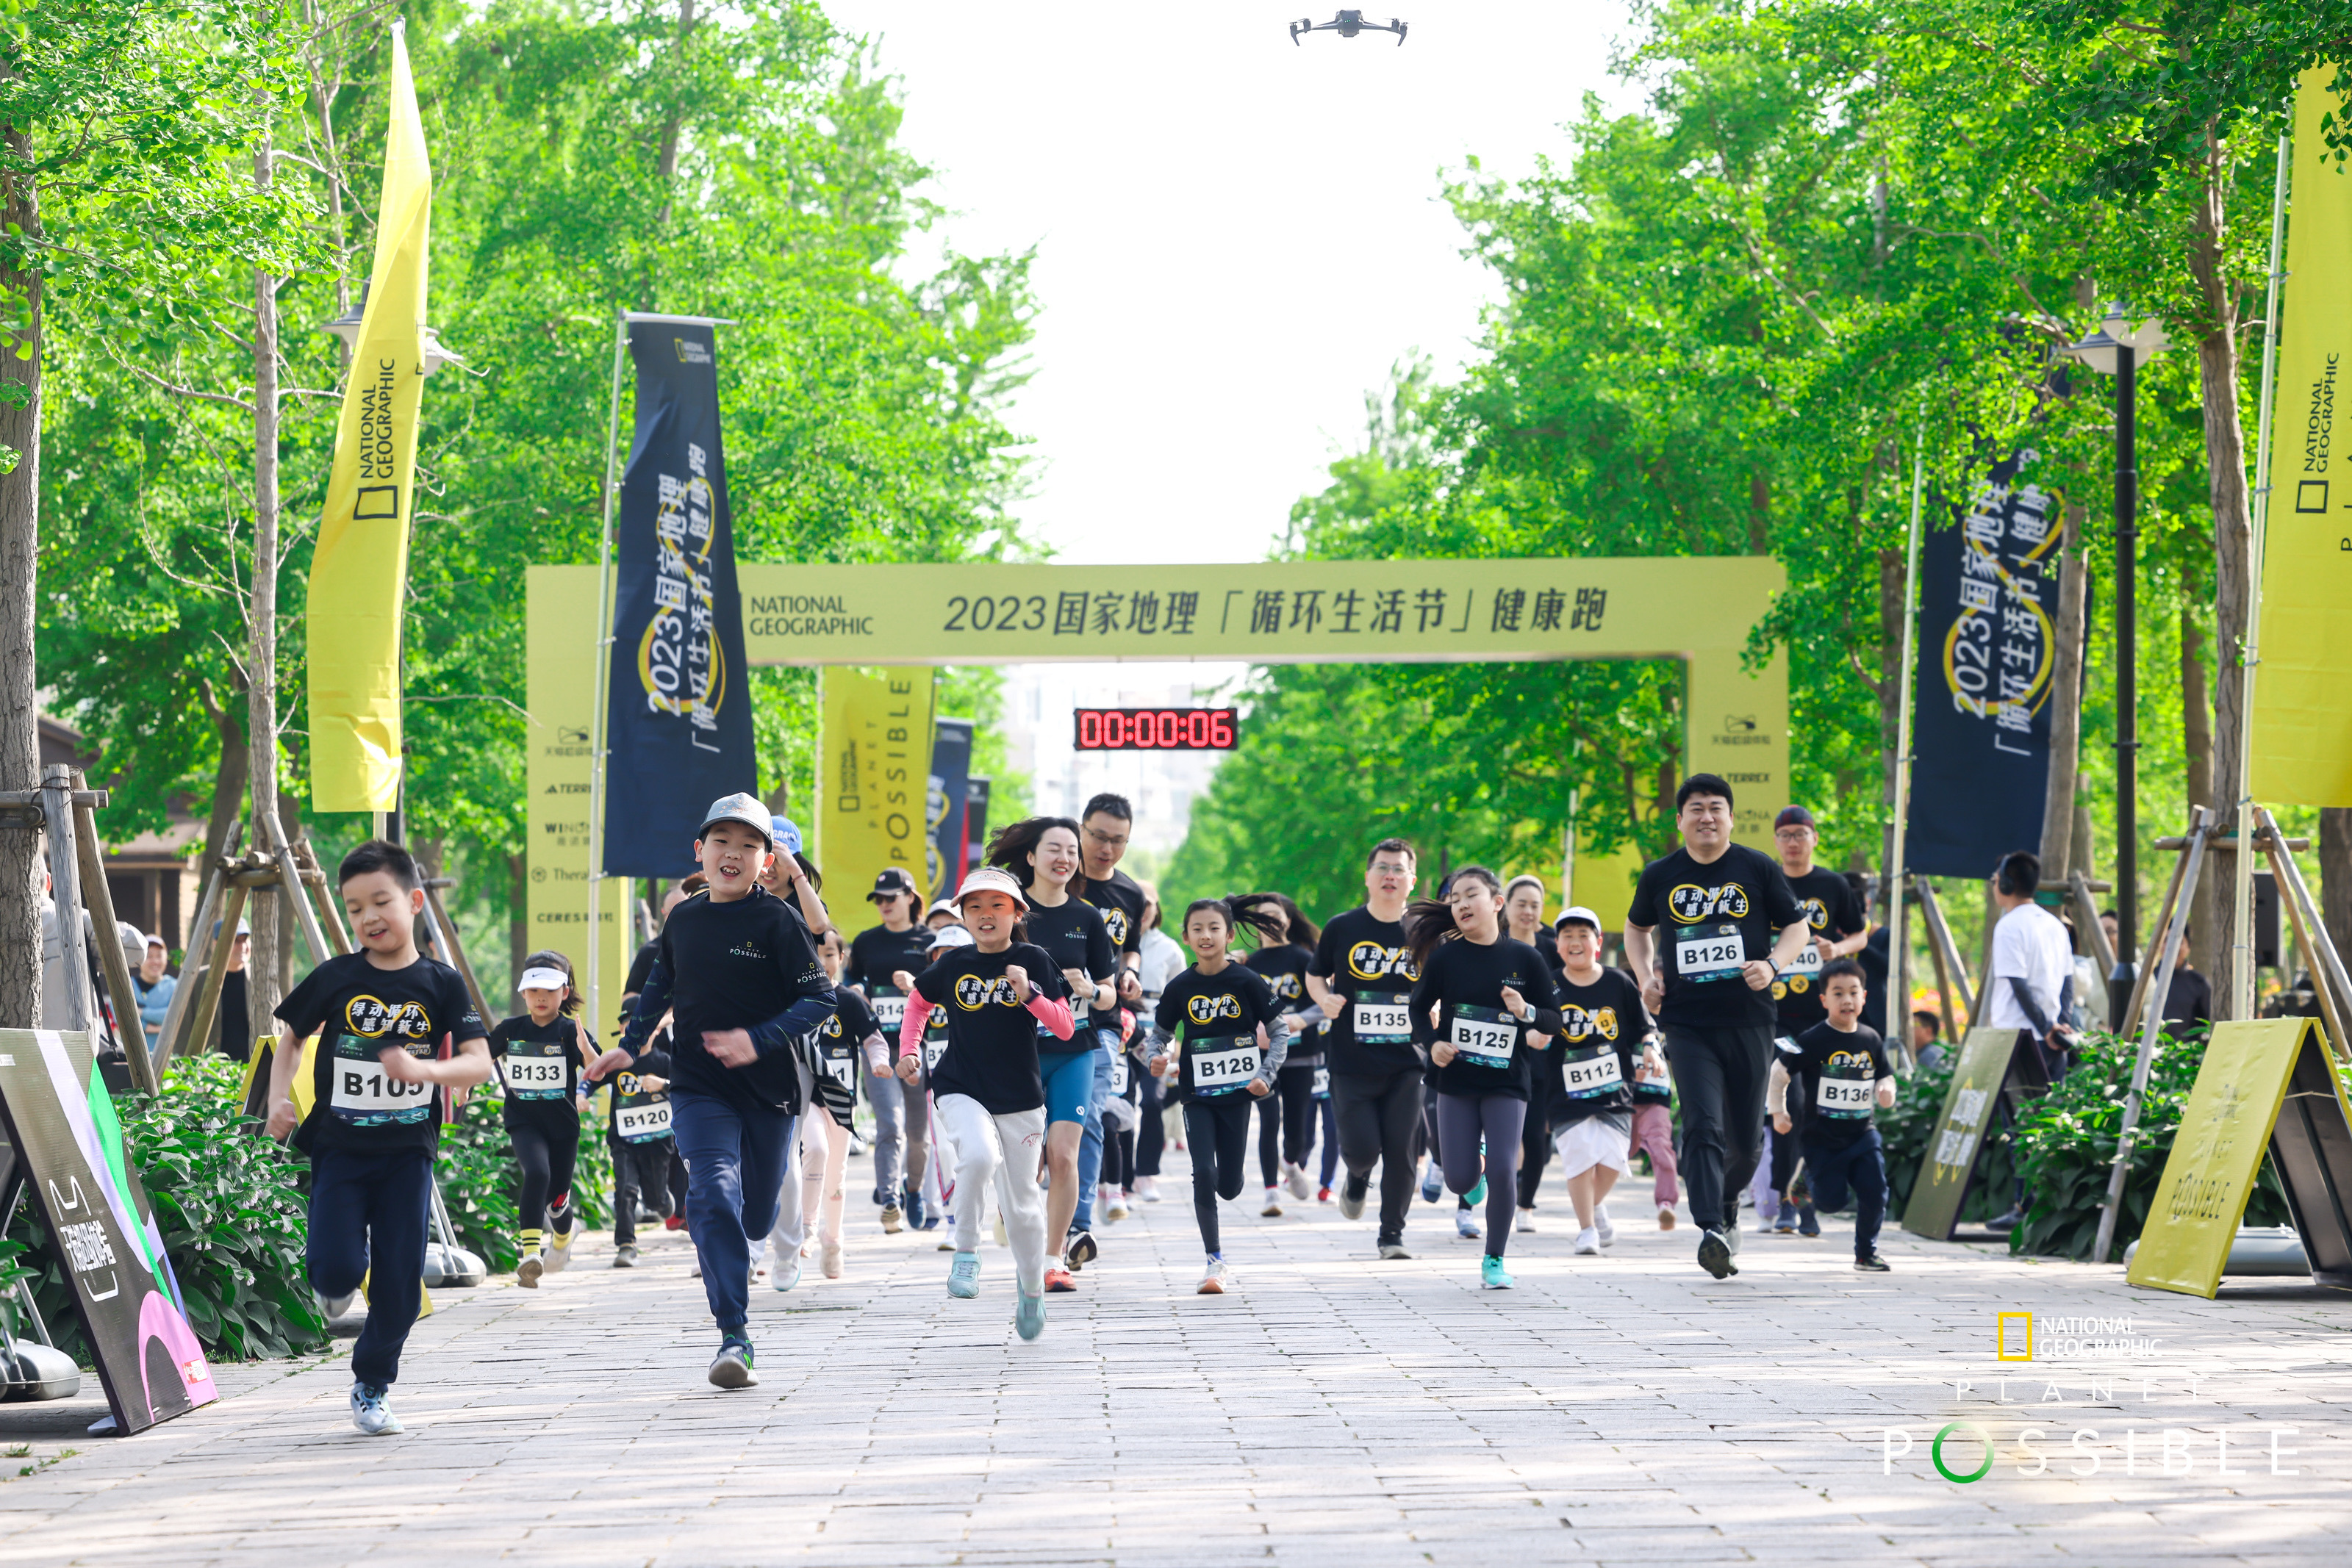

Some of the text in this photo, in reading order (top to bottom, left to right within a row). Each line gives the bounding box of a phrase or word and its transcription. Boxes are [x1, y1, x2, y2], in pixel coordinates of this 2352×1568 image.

[376, 359, 395, 479] GEOGRAPHIC
[2317, 353, 2340, 473] GEOGRAPHIC
[359, 384, 376, 478] NATIONAL
[2303, 378, 2323, 472] NATIONAL
[647, 473, 688, 718] 2023国家地理
[750, 595, 847, 614] NATIONAL
[943, 587, 1608, 636] 2023国家地理「循环生活节」健康跑
[749, 616, 874, 636] GEOGRAPHIC
[1079, 711, 1233, 748] 00:00:06
[886, 680, 912, 862] POSSIBLE
[1674, 885, 1736, 905] 绿动循环
[1685, 899, 1747, 917] 感知新生
[729, 949, 767, 959] POSSIBLE
[1684, 945, 1737, 965] B126
[797, 971, 827, 984] POSSIBLE
[351, 1001, 420, 1020] 绿动循环
[1360, 1013, 1408, 1026] B135
[361, 1018, 429, 1034] 感知新生
[1458, 1027, 1510, 1049] B125
[512, 1064, 560, 1081] B133
[1200, 1057, 1255, 1077] B128
[1570, 1062, 1614, 1083] B112
[1825, 1086, 1870, 1101] B136
[623, 1110, 668, 1128] B120
